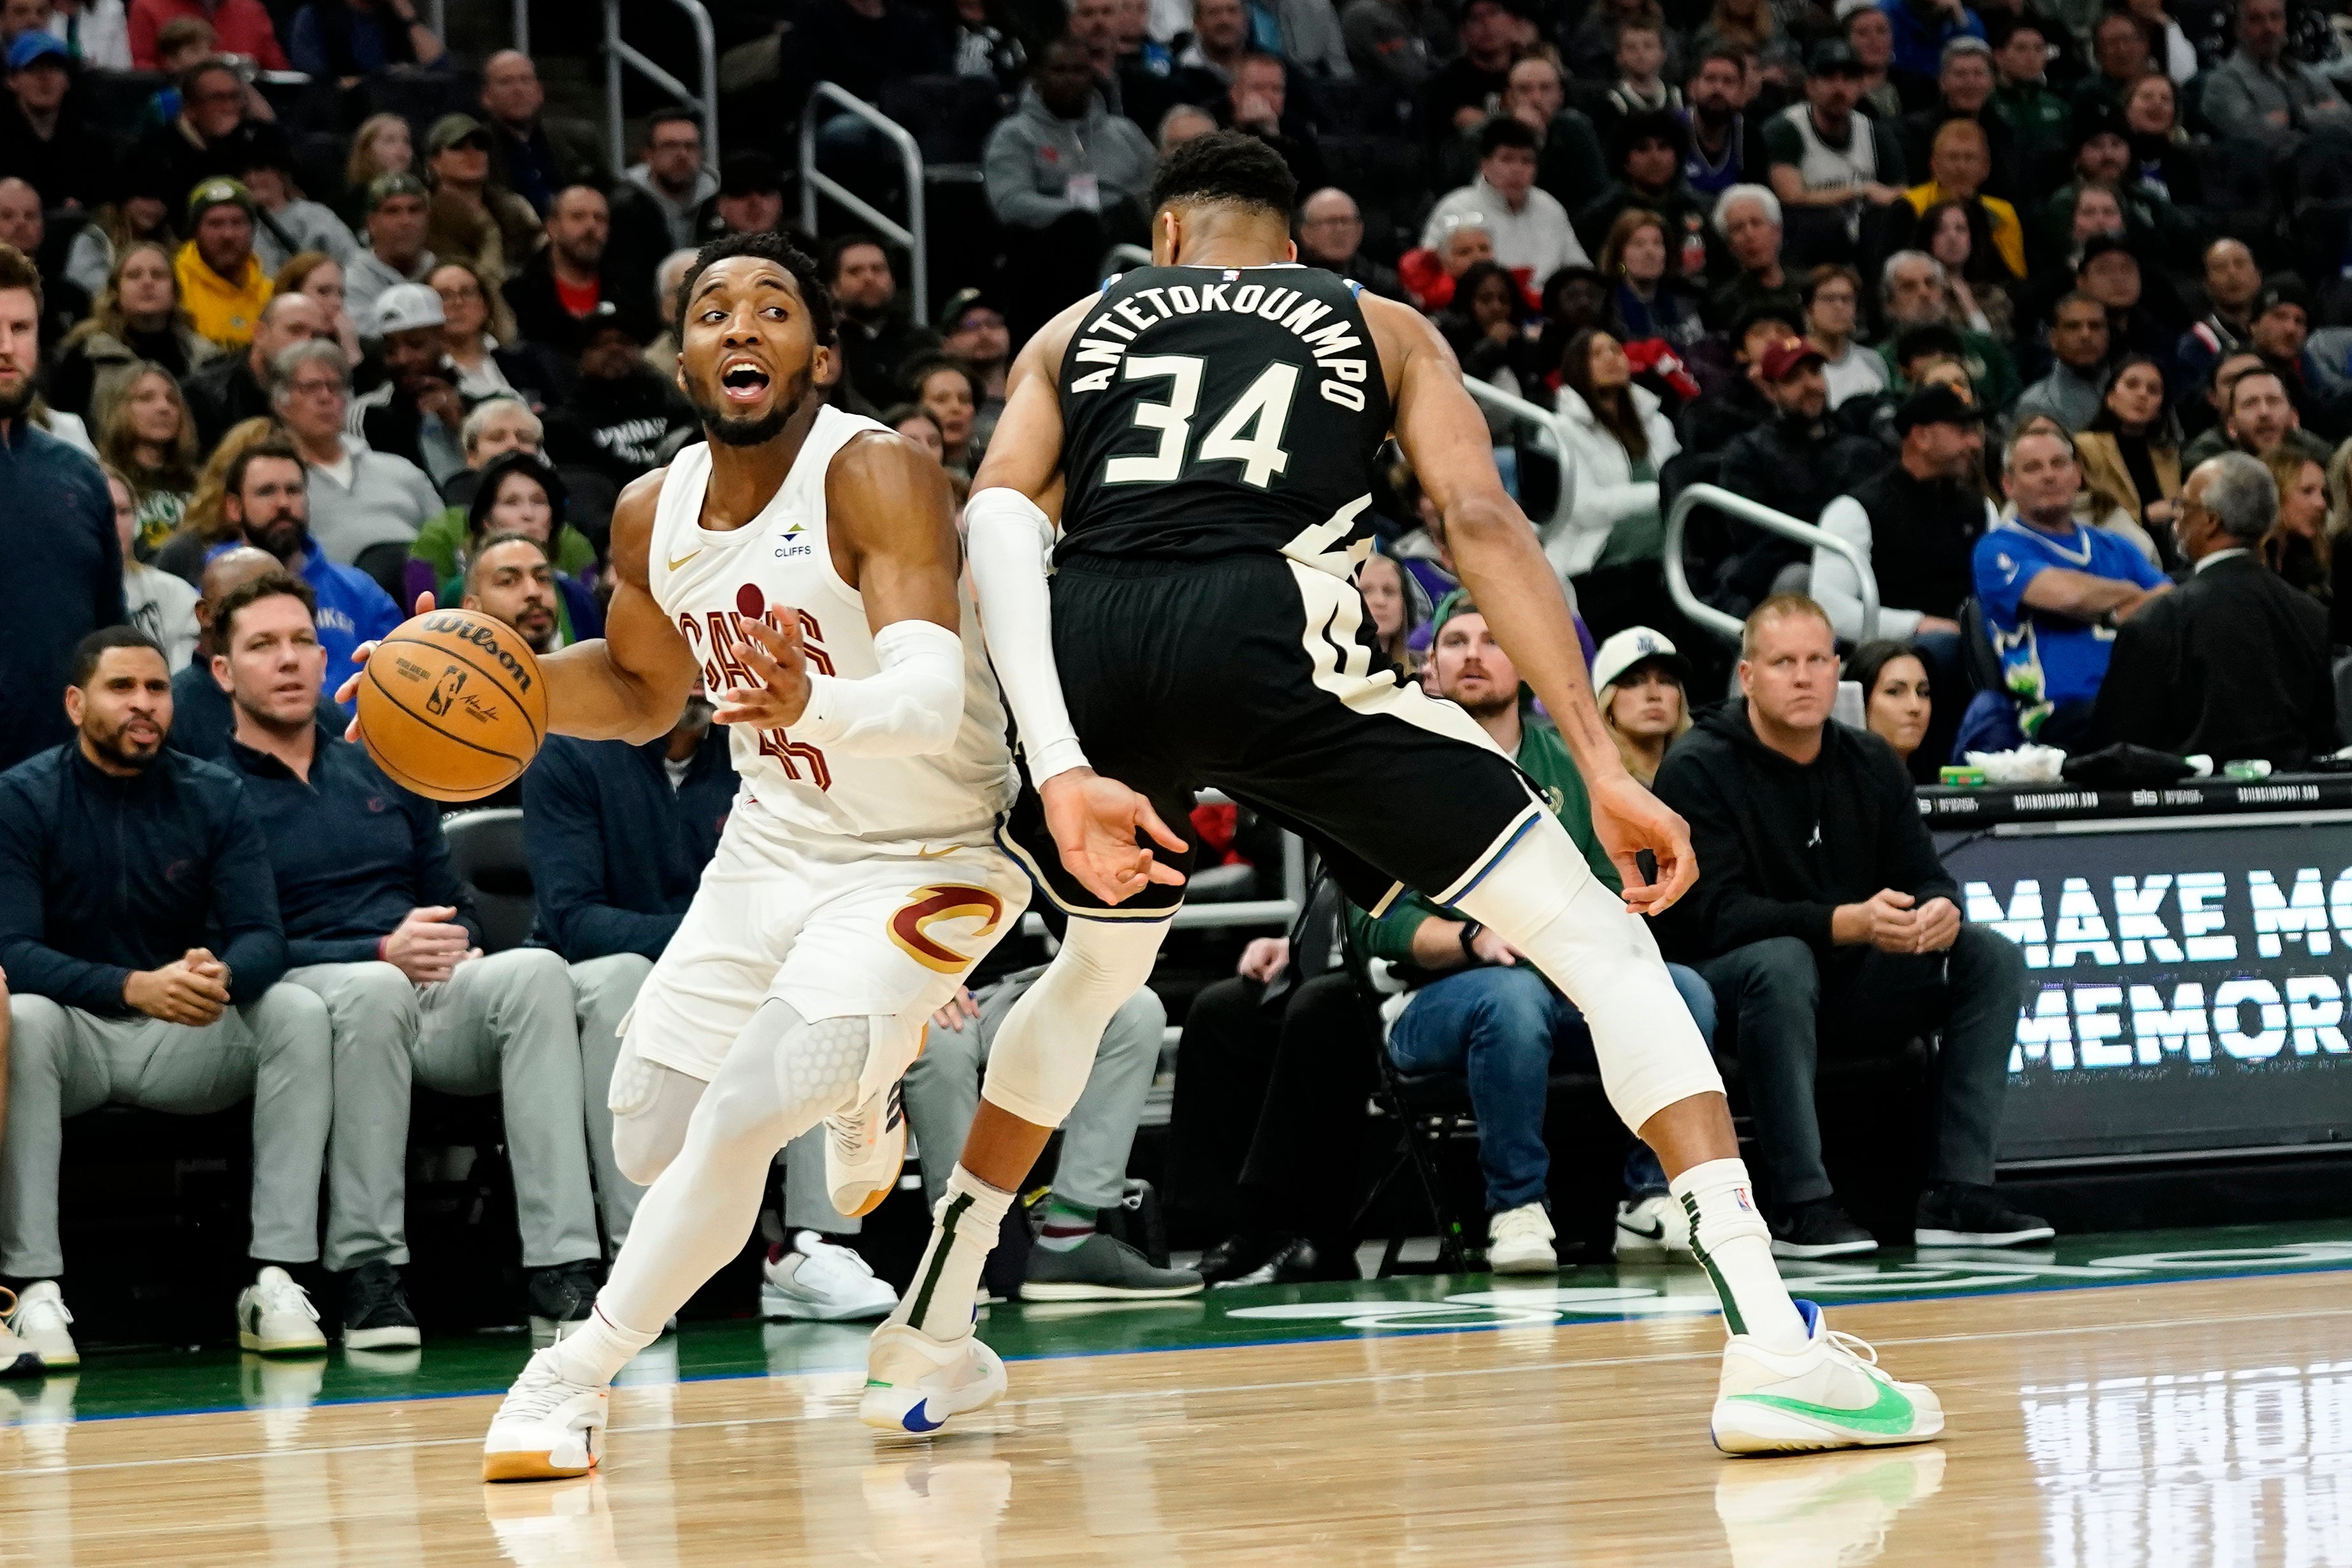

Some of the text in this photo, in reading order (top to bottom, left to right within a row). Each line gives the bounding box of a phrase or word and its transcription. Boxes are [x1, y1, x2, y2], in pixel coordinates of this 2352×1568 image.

[1071, 284, 1367, 412] ANTETOKOUNMPO
[1102, 352, 1304, 492] 34
[774, 544, 812, 558] CLIFFS
[1964, 872, 2238, 969] MAKE
[2008, 977, 2352, 1074] MEMOR
